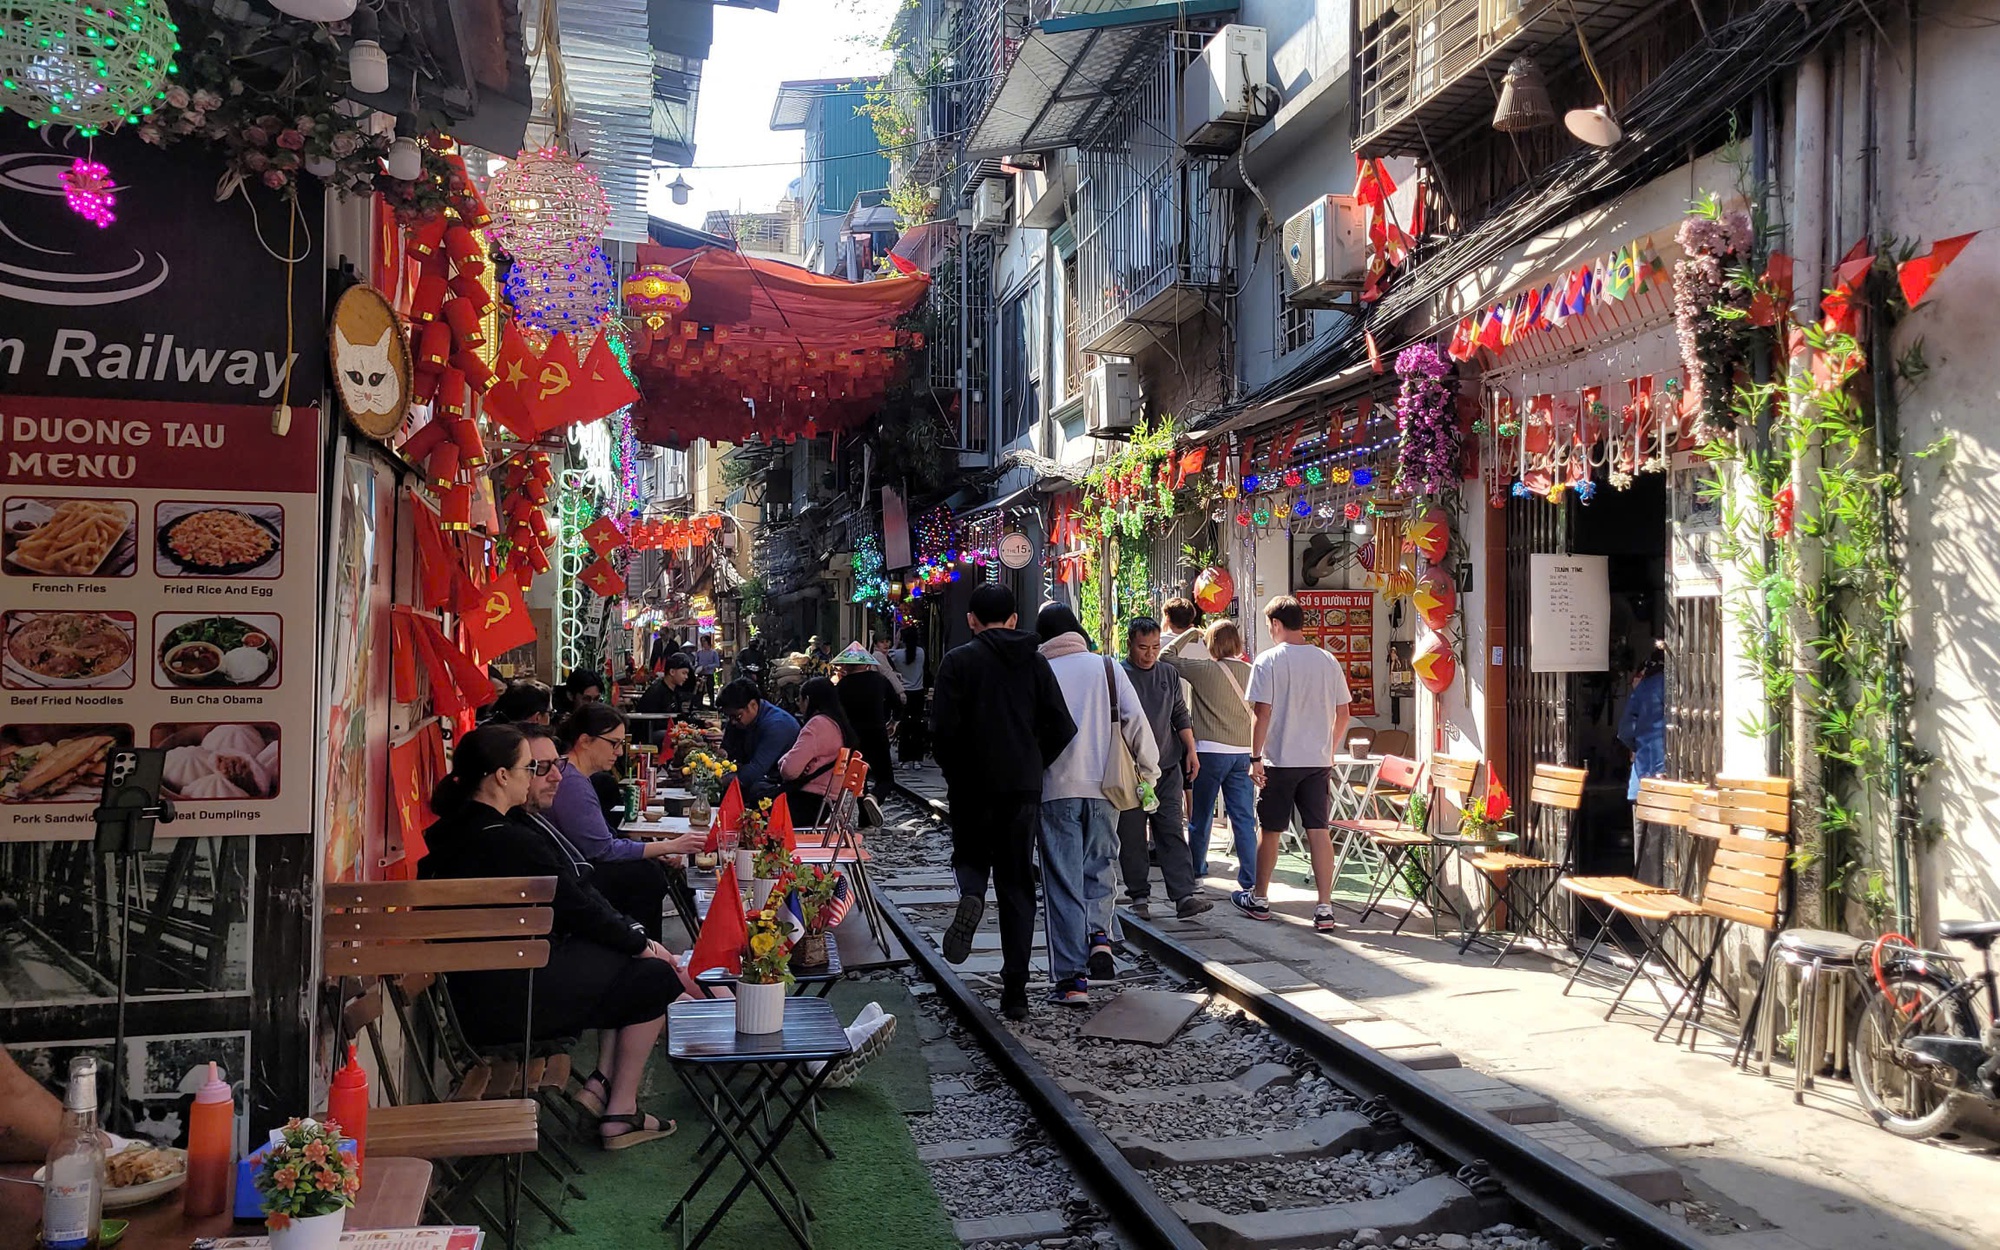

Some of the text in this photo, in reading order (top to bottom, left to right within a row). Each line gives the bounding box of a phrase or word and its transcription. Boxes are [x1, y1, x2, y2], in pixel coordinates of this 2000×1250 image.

[47, 328, 300, 399] Railway
[13, 416, 152, 446] DUONG
[162, 422, 226, 449] TAU
[7, 451, 137, 479] MENU
[32, 582, 107, 593] French Fries
[163, 584, 273, 597] Fried Rice And Egg
[1314, 596, 1320, 606] 9
[10, 695, 124, 706] Beef Fried Noodles
[170, 694, 263, 705] Bun Cha Obama
[13, 813, 96, 824] Pork Sandwic
[174, 809, 261, 822] eat Dumplings
